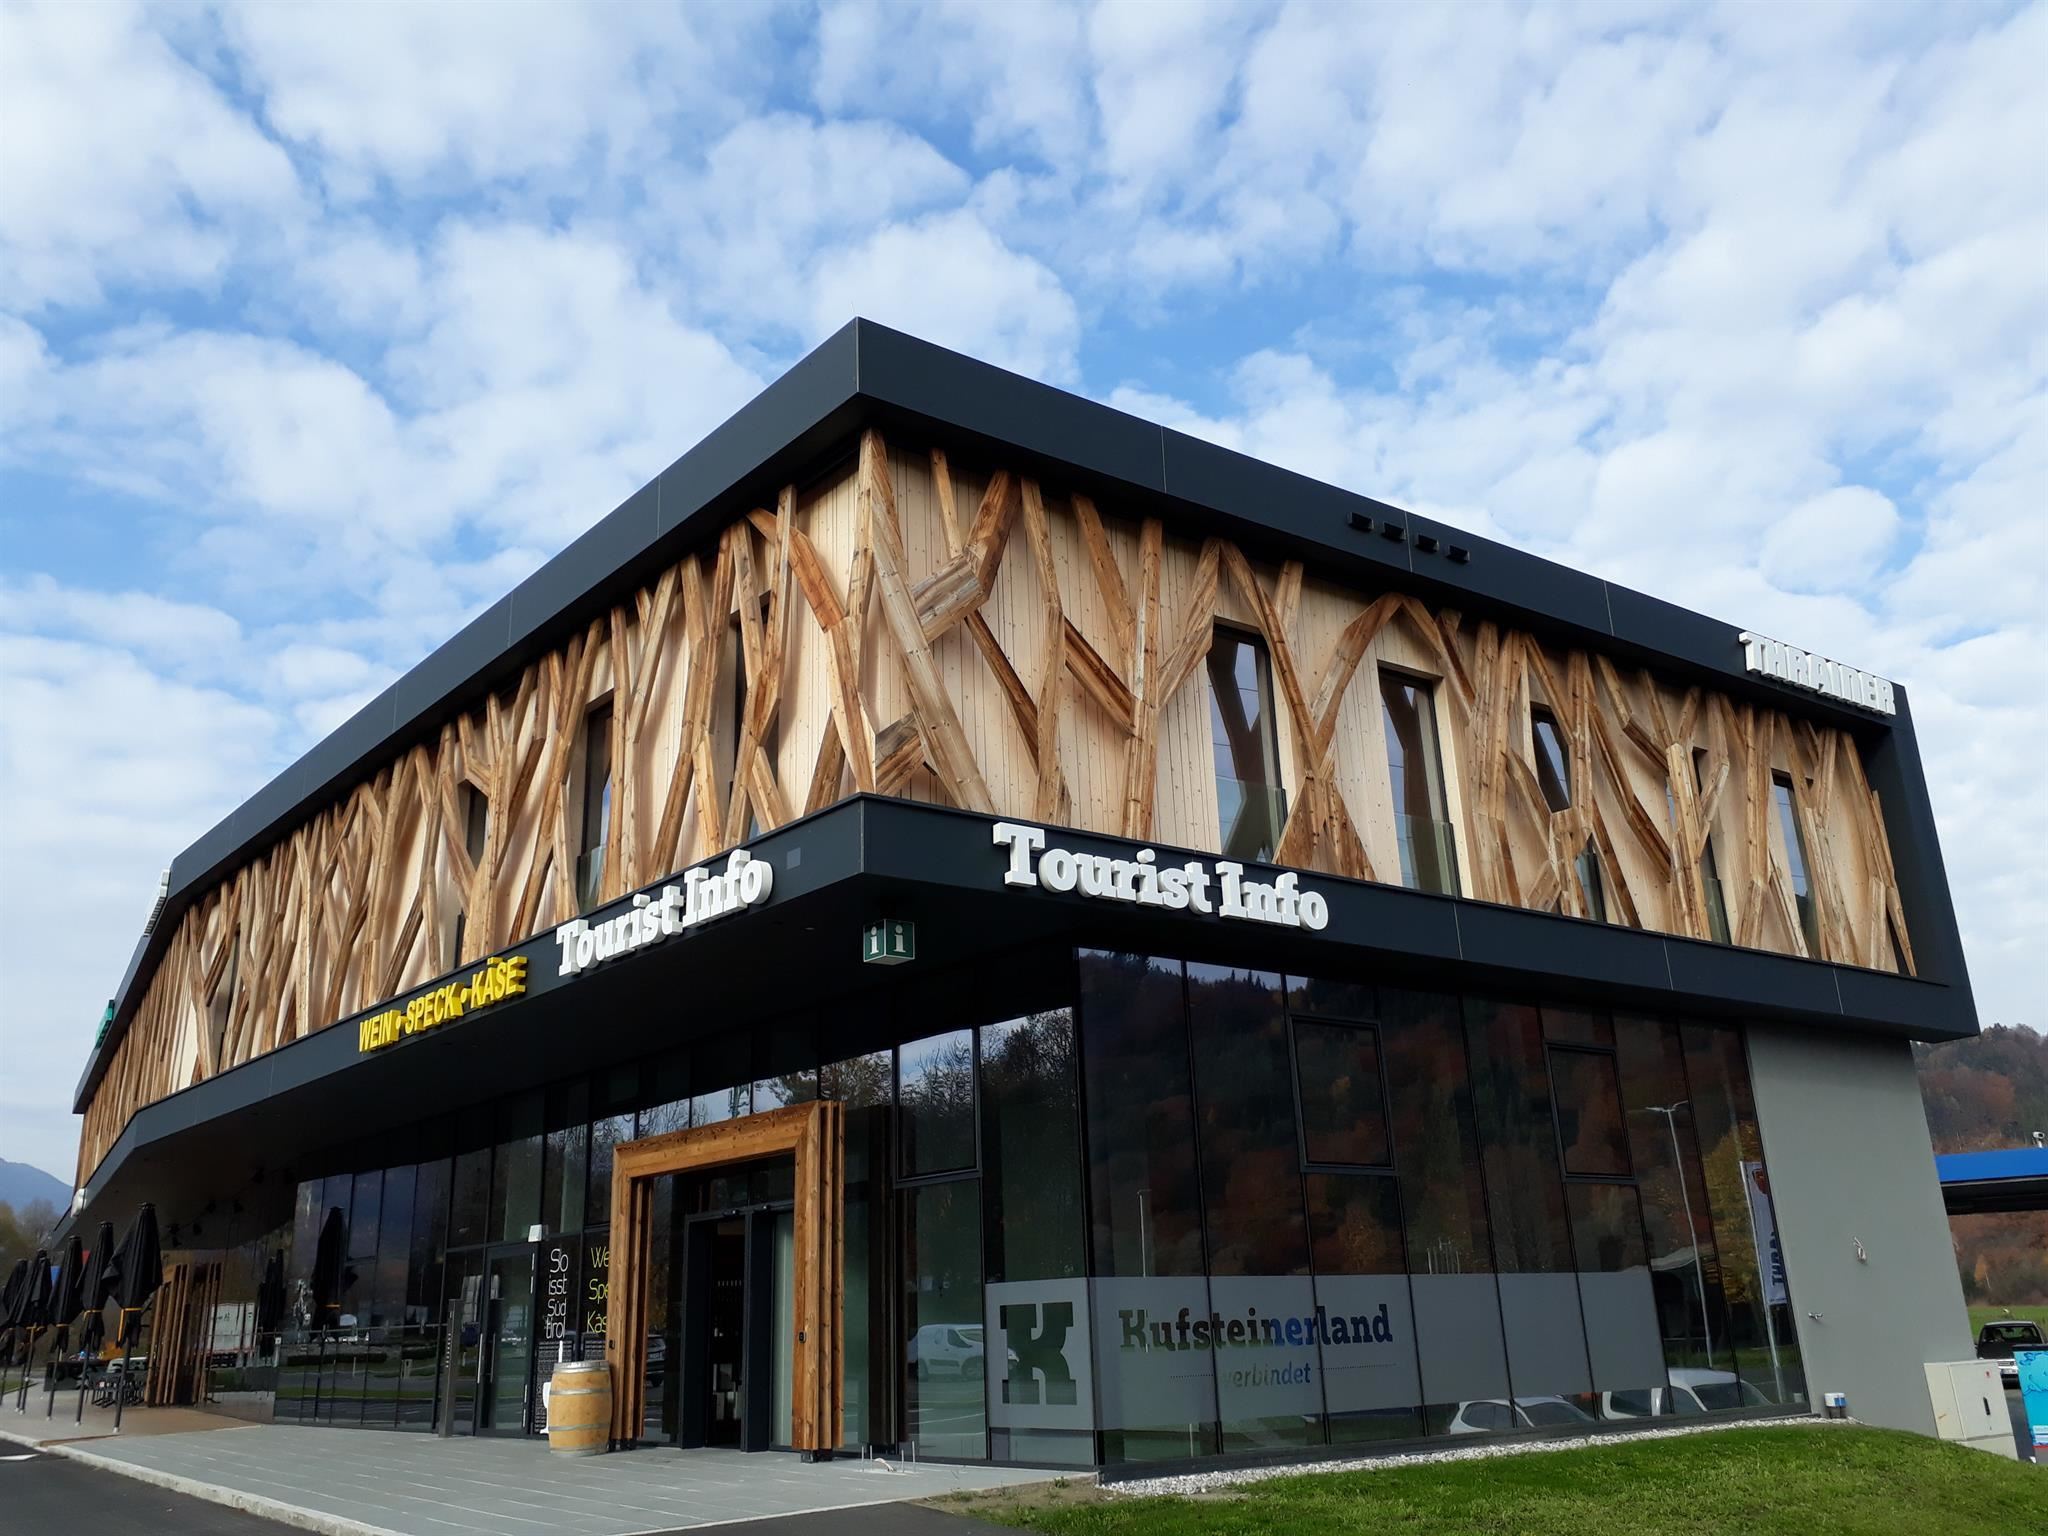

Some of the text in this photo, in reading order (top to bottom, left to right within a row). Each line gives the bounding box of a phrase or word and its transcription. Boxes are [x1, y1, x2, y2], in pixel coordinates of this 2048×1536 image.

[992, 821, 1330, 931] Tourist Info
[556, 849, 774, 977] Tourist Info
[549, 1247, 569, 1274] So
[590, 1246, 610, 1269] We
[548, 1273, 568, 1296] isst
[547, 1297, 567, 1318] Süd
[586, 1310, 608, 1334] Käs
[1118, 1303, 1393, 1352] Kufsteinerland
[1223, 1360, 1311, 1388] erbindet
